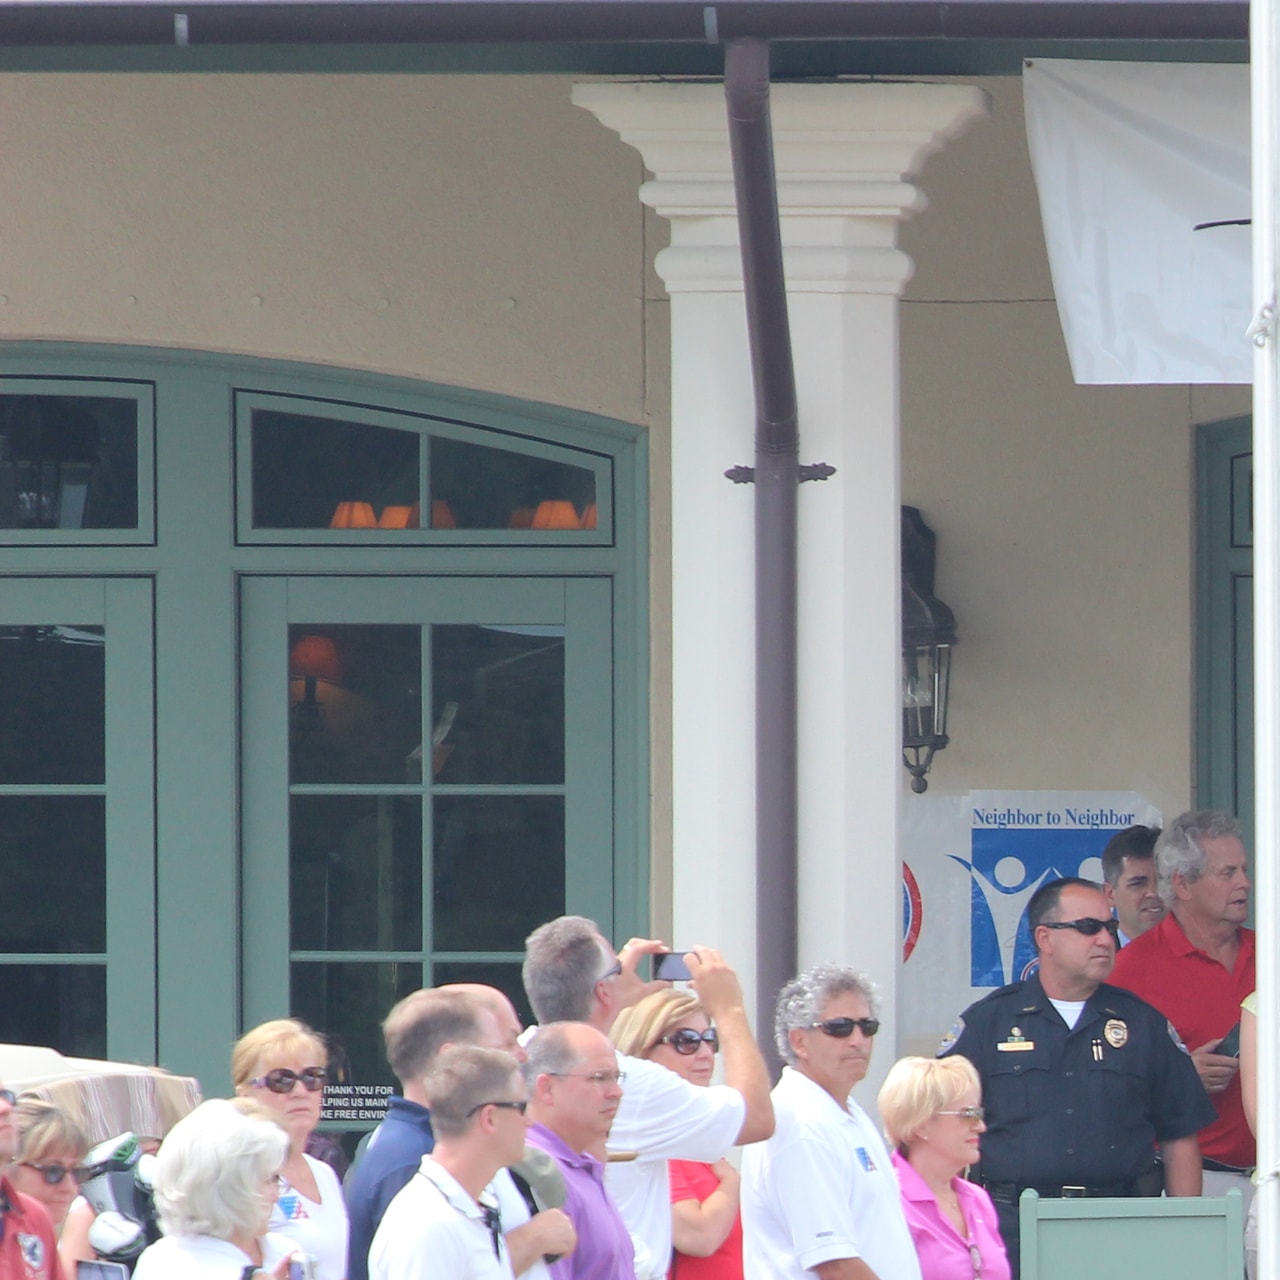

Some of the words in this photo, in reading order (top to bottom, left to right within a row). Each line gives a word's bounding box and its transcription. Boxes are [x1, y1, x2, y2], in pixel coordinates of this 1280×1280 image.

[972, 808, 1043, 829] Neighbor
[1046, 810, 1061, 825] to
[1065, 808, 1136, 829] Neighbor
[323, 1085, 353, 1095] THANK
[354, 1085, 374, 1095] YOU
[375, 1086, 394, 1095] FOR
[350, 1098, 364, 1107] US
[364, 1098, 391, 1107] MAIN
[334, 1110, 358, 1119] FREE
